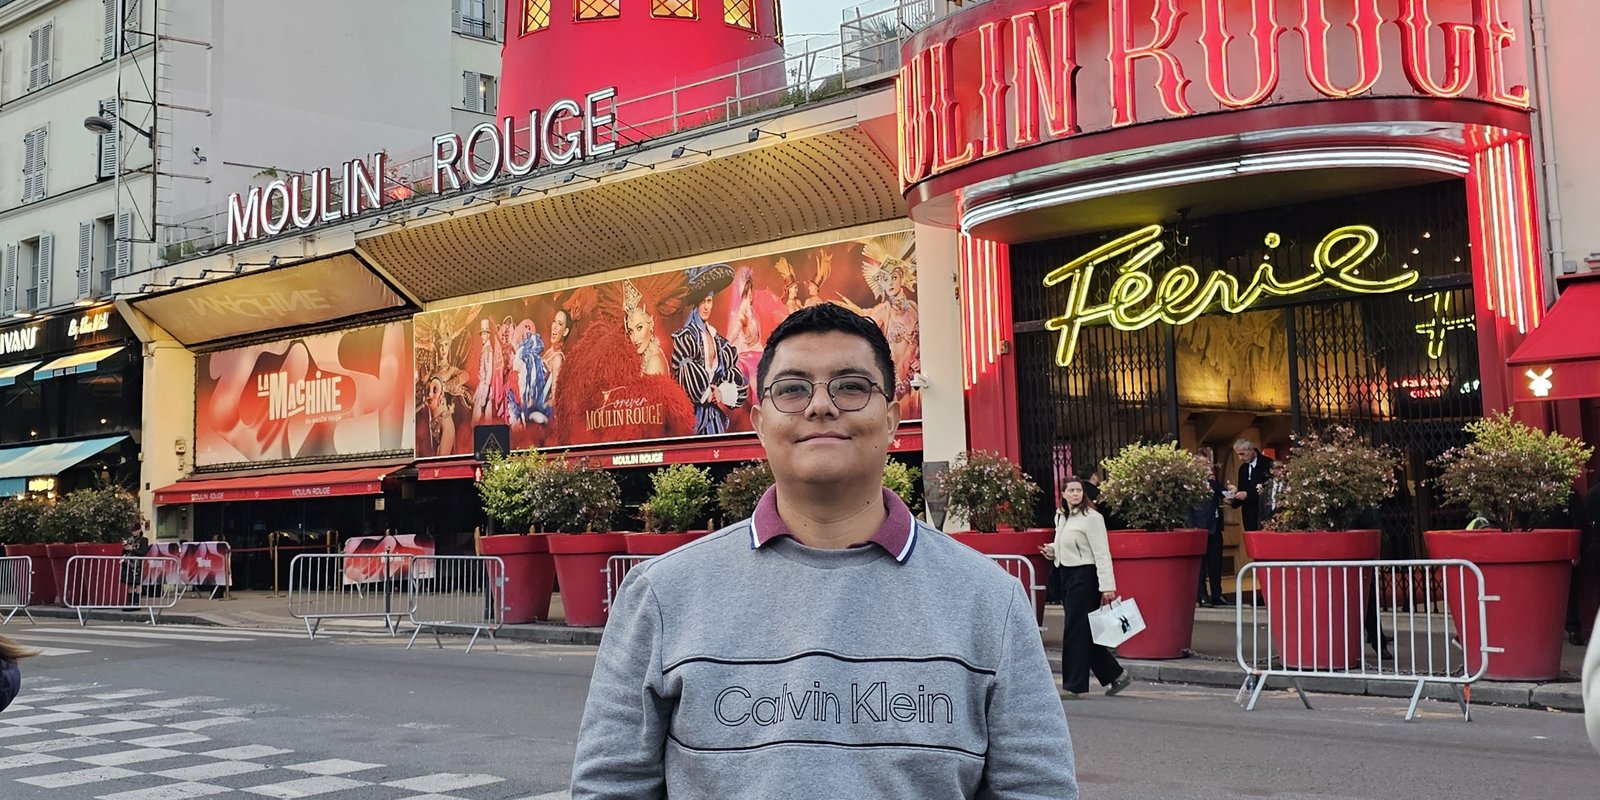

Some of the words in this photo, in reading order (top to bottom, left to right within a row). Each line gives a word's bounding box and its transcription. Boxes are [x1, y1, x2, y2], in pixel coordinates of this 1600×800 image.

[1107, 0, 1529, 126] ROUGE
[226, 152, 384, 245] MOULIN
[431, 86, 617, 195] ROUGE
[1043, 223, 1419, 367] Féerie
[257, 374, 269, 391] LA
[597, 386, 648, 409] Forever
[586, 408, 624, 431] MOULIN
[625, 402, 664, 425] ROUGE
[612, 454, 639, 466] MOULIN
[639, 452, 664, 464] ROUGE
[714, 681, 841, 727] Calvin
[851, 681, 953, 724] Klein
